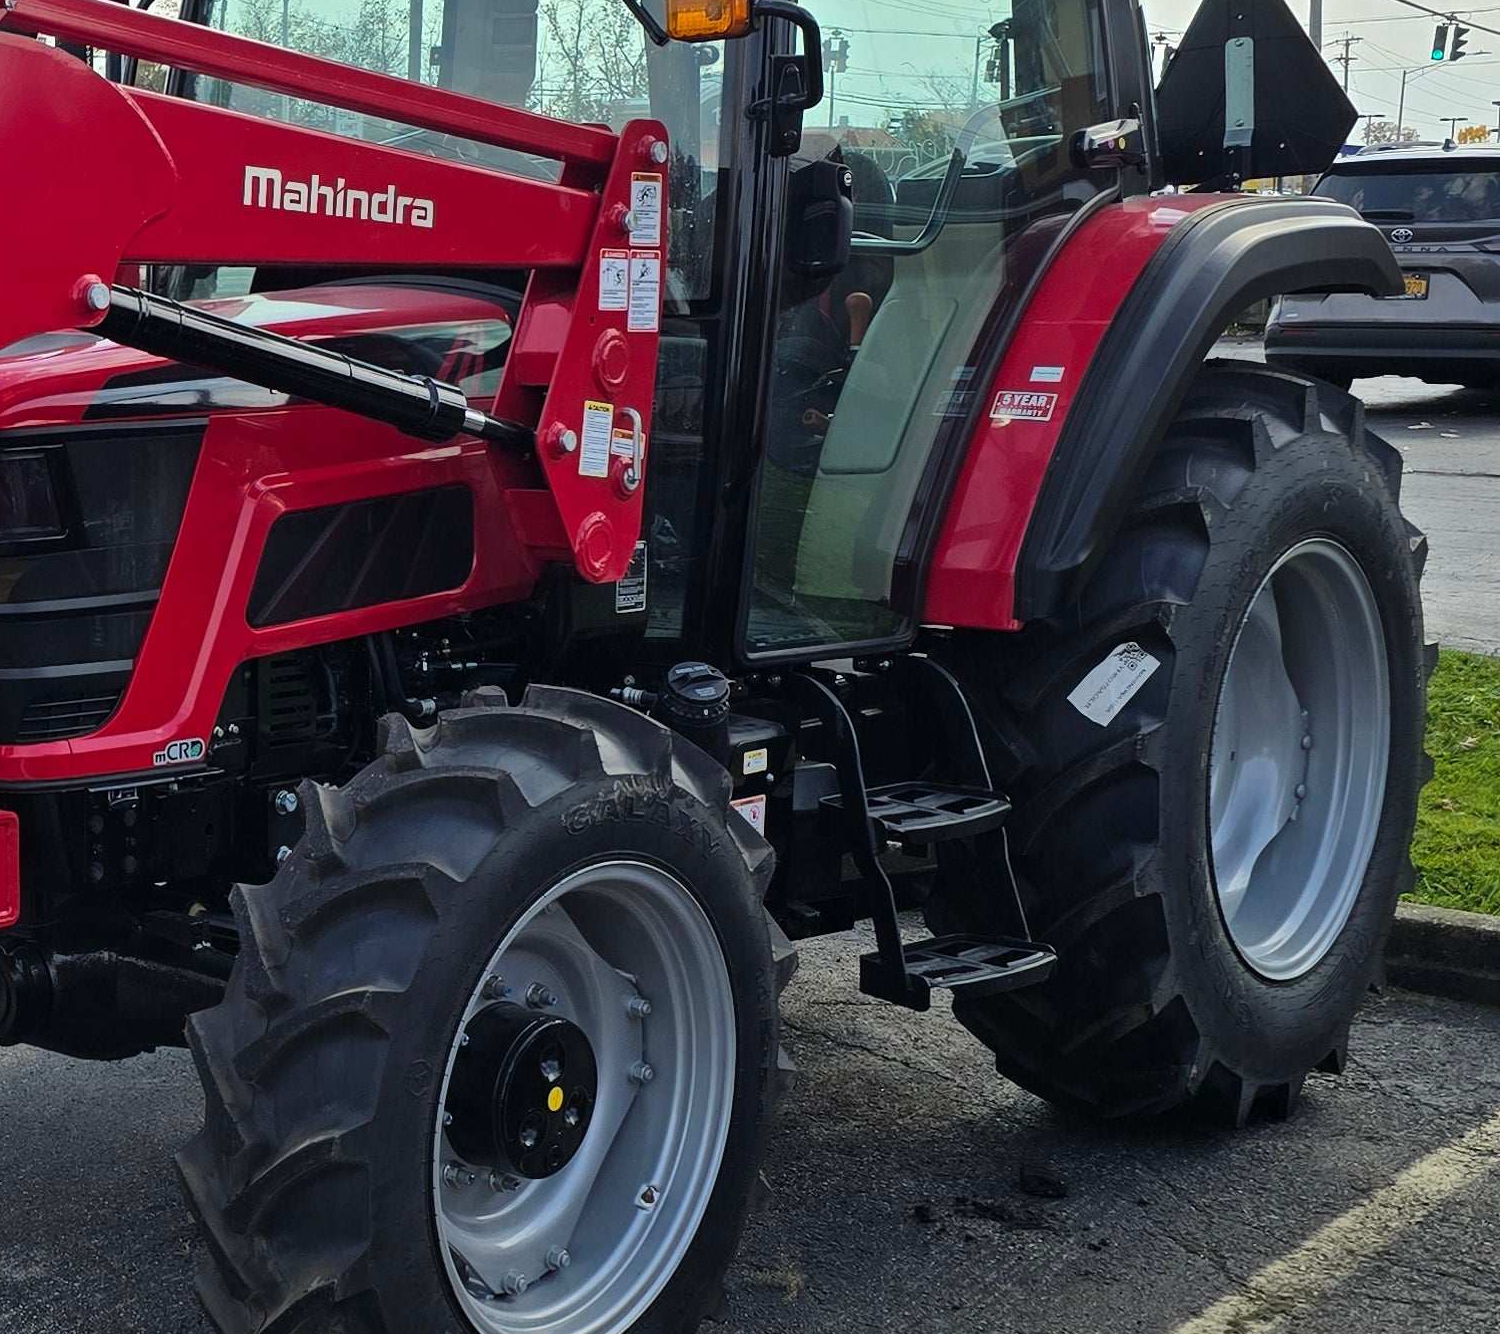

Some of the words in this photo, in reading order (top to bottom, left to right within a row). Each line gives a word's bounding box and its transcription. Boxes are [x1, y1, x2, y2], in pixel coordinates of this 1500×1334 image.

[243, 165, 435, 228] Mahindra
[999, 407, 1044, 417] WARRANTY
[1002, 394, 1013, 406] 5
[1014, 394, 1048, 407] YEAR
[564, 792, 722, 860] GALAXY
